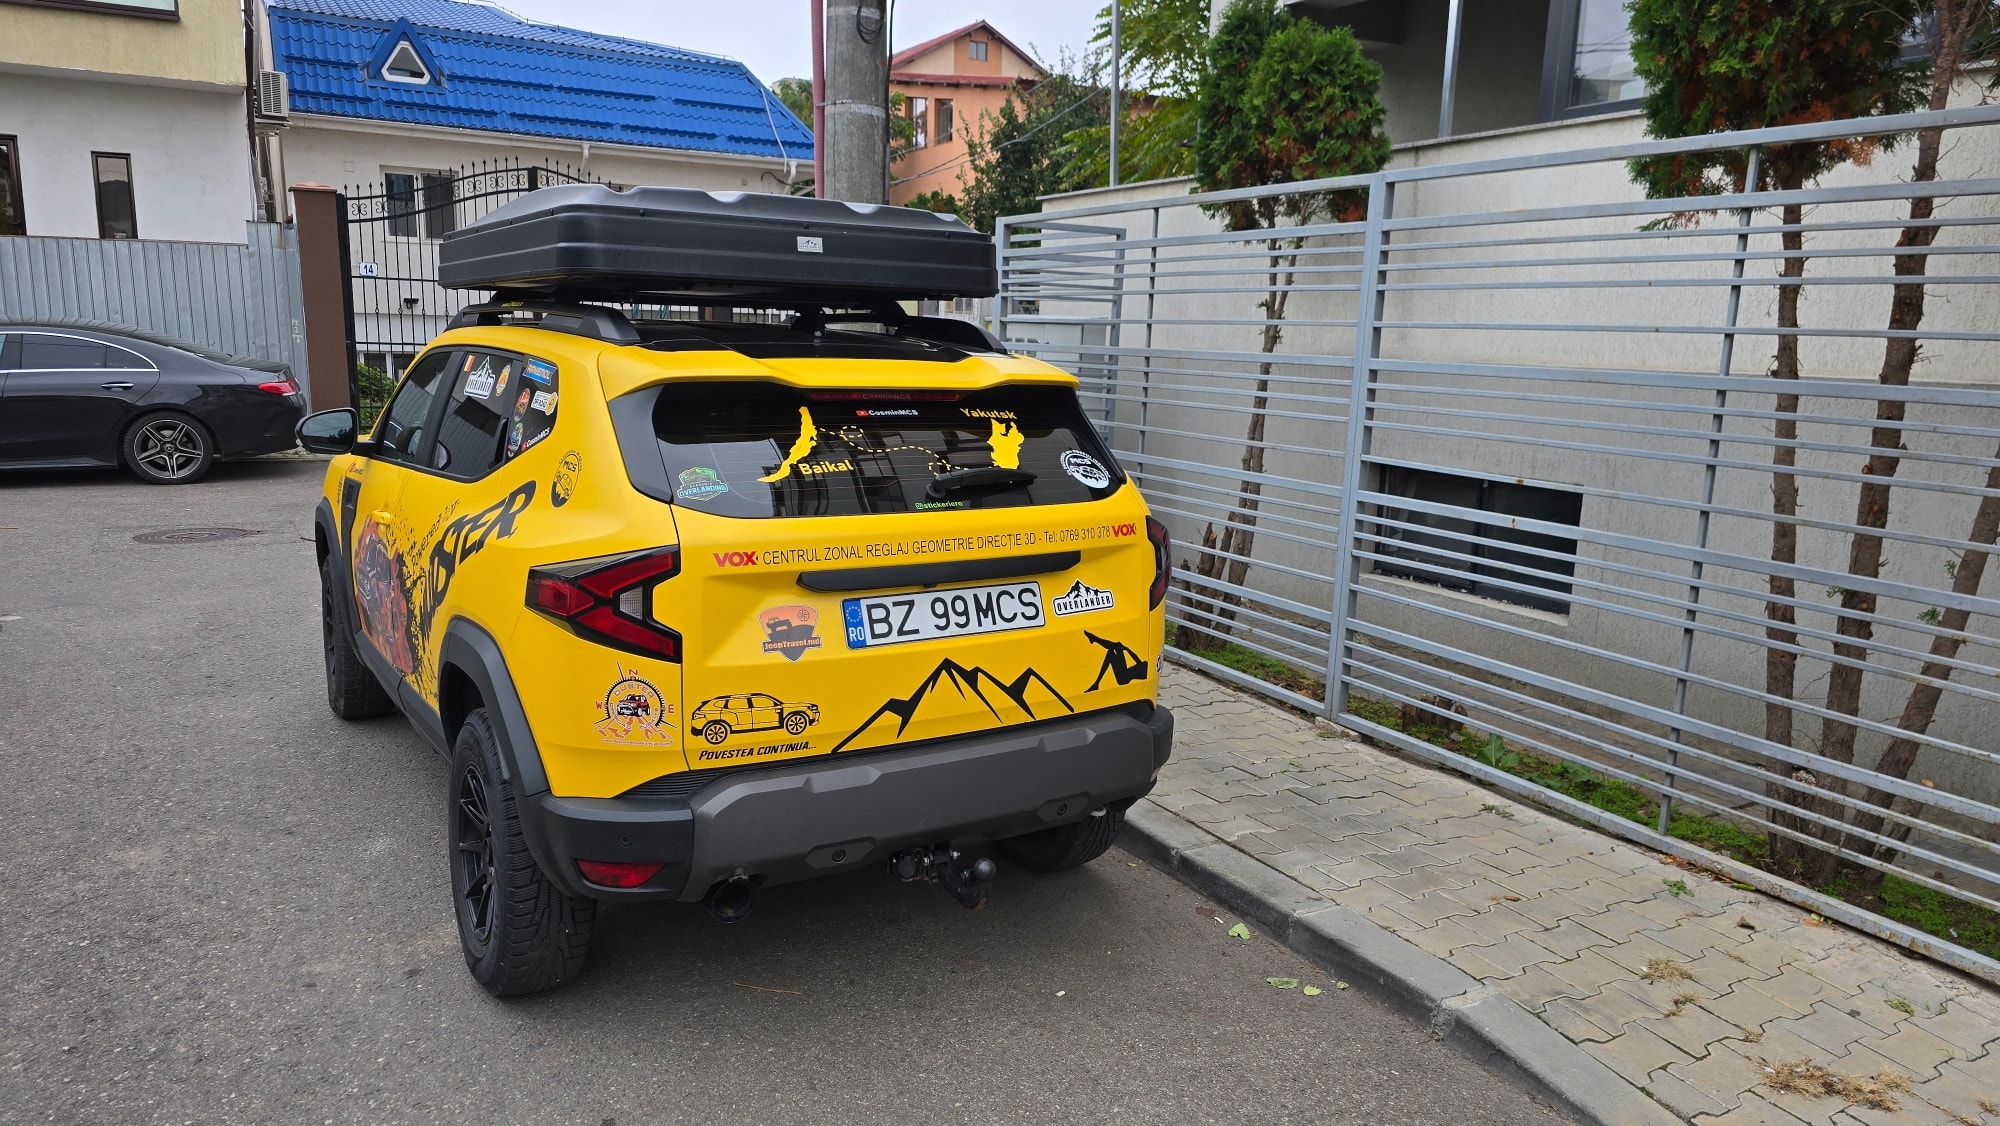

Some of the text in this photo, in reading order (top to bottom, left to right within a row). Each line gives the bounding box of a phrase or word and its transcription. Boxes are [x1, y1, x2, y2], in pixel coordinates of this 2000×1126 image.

[363, 264, 374, 275] 14
[959, 408, 1018, 420] Yakutsk
[563, 460, 578, 472] MCS
[798, 459, 854, 476] Baikal
[1069, 457, 1092, 465] MCS
[679, 484, 728, 498] OVERLANDING
[713, 550, 757, 568] VOX
[762, 547, 821, 565] CENTRUL
[824, 545, 863, 560] ZONAL
[866, 542, 909, 558] REGLAJ
[912, 537, 974, 554] GEOMETRIE
[977, 534, 1022, 551] DIRECȚIE
[1024, 532, 1036, 545] 3D
[1044, 531, 1058, 543] Tel:
[1060, 528, 1080, 542] 0769
[1082, 527, 1095, 540] 310
[1097, 525, 1110, 538] 378
[1112, 523, 1136, 538] VOX
[1057, 595, 1111, 612] OVERLANDER
[865, 587, 1040, 640] BZ 99 MCS
[849, 627, 864, 642] RO
[764, 637, 821, 650] JeepTravel.md
[614, 683, 655, 699] DUSTER
[595, 701, 603, 710] W
[668, 704, 674, 713] E
[698, 747, 755, 761] POVESTEA
